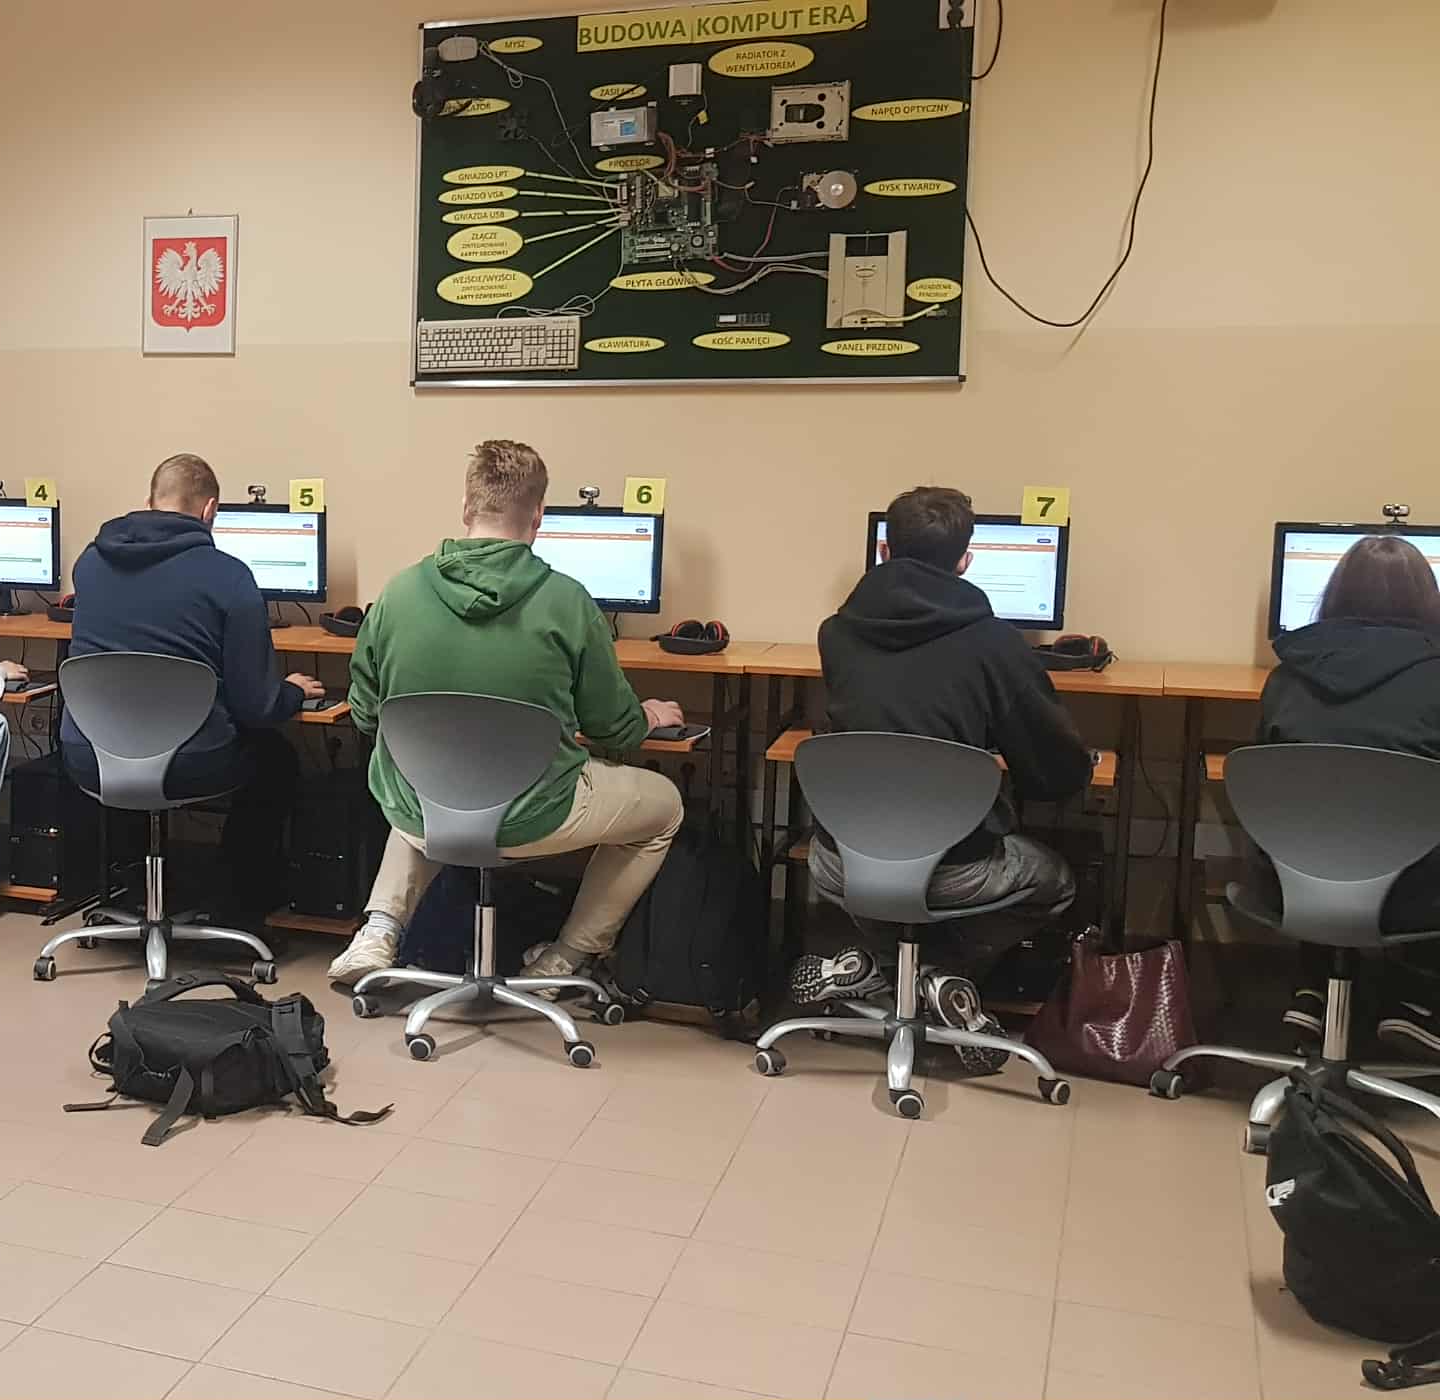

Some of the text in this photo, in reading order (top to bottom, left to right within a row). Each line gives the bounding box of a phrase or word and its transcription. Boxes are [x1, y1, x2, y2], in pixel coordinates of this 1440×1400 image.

[578, 19, 687, 46] BUDOWA
[504, 40, 526, 49] MYSZ
[735, 50, 778, 60] RADIATOR
[725, 61, 796, 73] WENTYLATOREM
[871, 103, 950, 117] NAPĘD OPTYCZNY
[608, 158, 650, 168] PROCESOR
[457, 171, 494, 181] GNIAZDO
[878, 182, 941, 192] DYSK TWARDY
[451, 191, 487, 201] GNIAZDO
[625, 278, 653, 288] PŁYTA
[598, 340, 650, 349] KLAWIATURA
[836, 343, 903, 352] PANEL PRZEDNI
[34, 484, 49, 501] 4
[299, 488, 314, 507] 5
[636, 485, 653, 504] 6
[1036, 496, 1056, 518] 7
